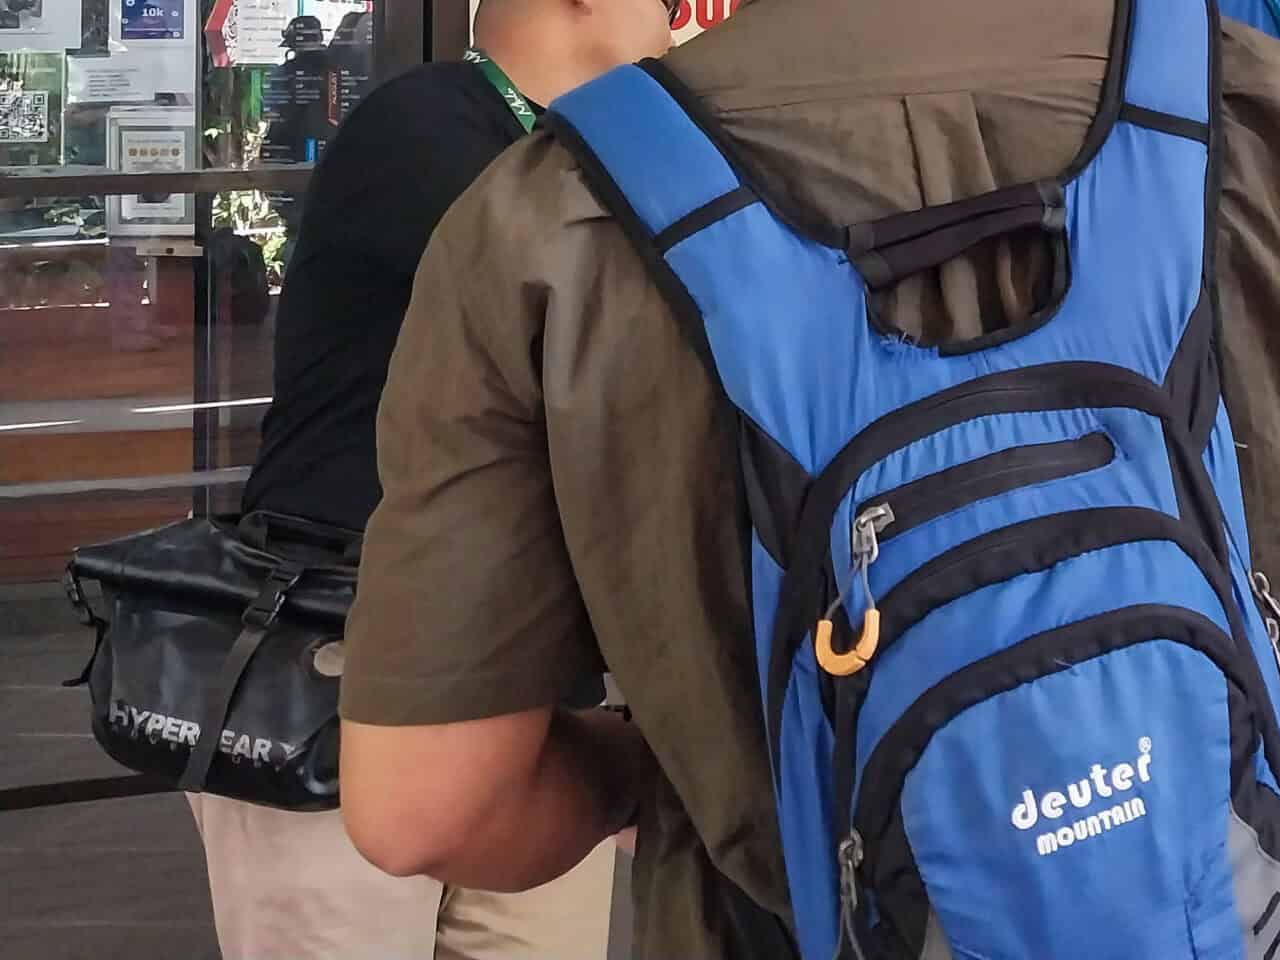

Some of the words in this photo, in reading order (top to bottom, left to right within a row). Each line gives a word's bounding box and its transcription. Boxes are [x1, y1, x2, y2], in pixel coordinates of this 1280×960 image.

[142, 7, 165, 17] 10k
[109, 700, 273, 762] HYPEREAR
[1011, 753, 1151, 830] deuter
